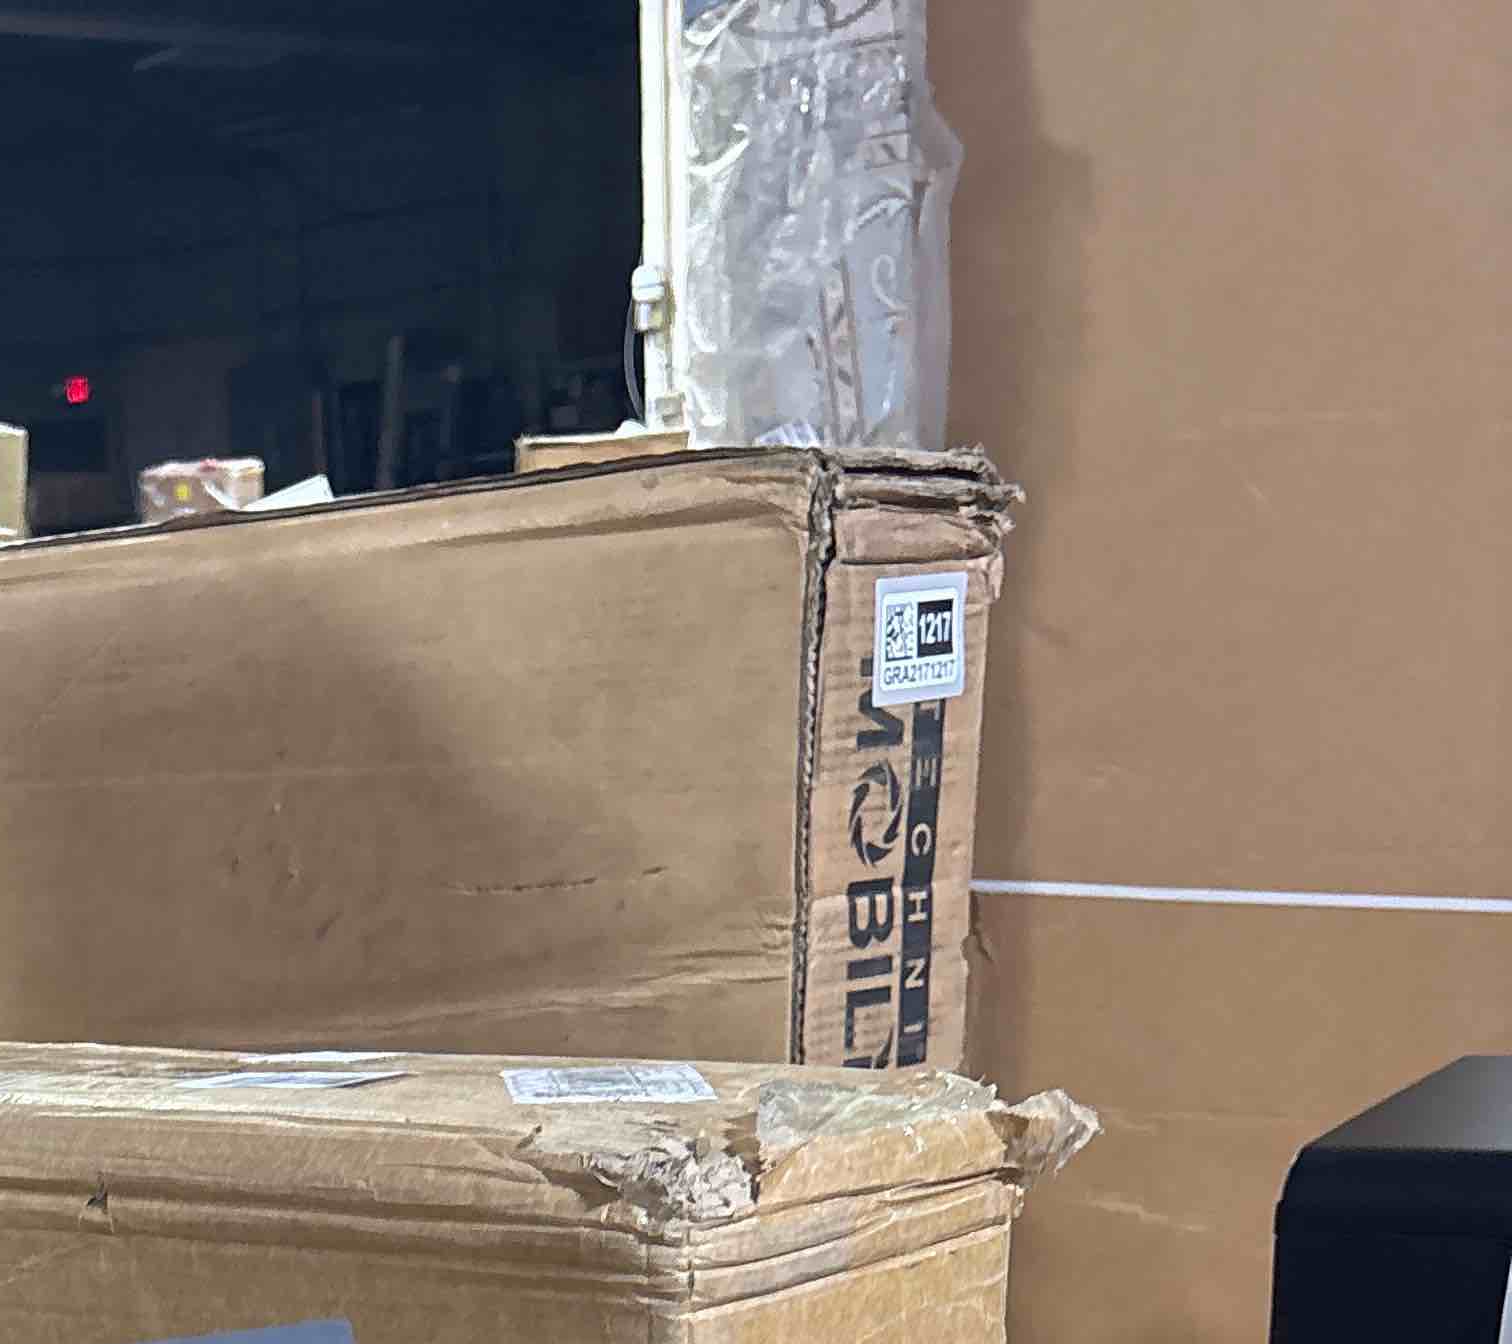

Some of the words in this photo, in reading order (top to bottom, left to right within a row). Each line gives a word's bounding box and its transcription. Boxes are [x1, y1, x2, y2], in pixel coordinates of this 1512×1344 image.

[919, 610, 952, 645] 1217
[883, 659, 956, 686] GRA2171217
[841, 656, 905, 1069] MOBIL
